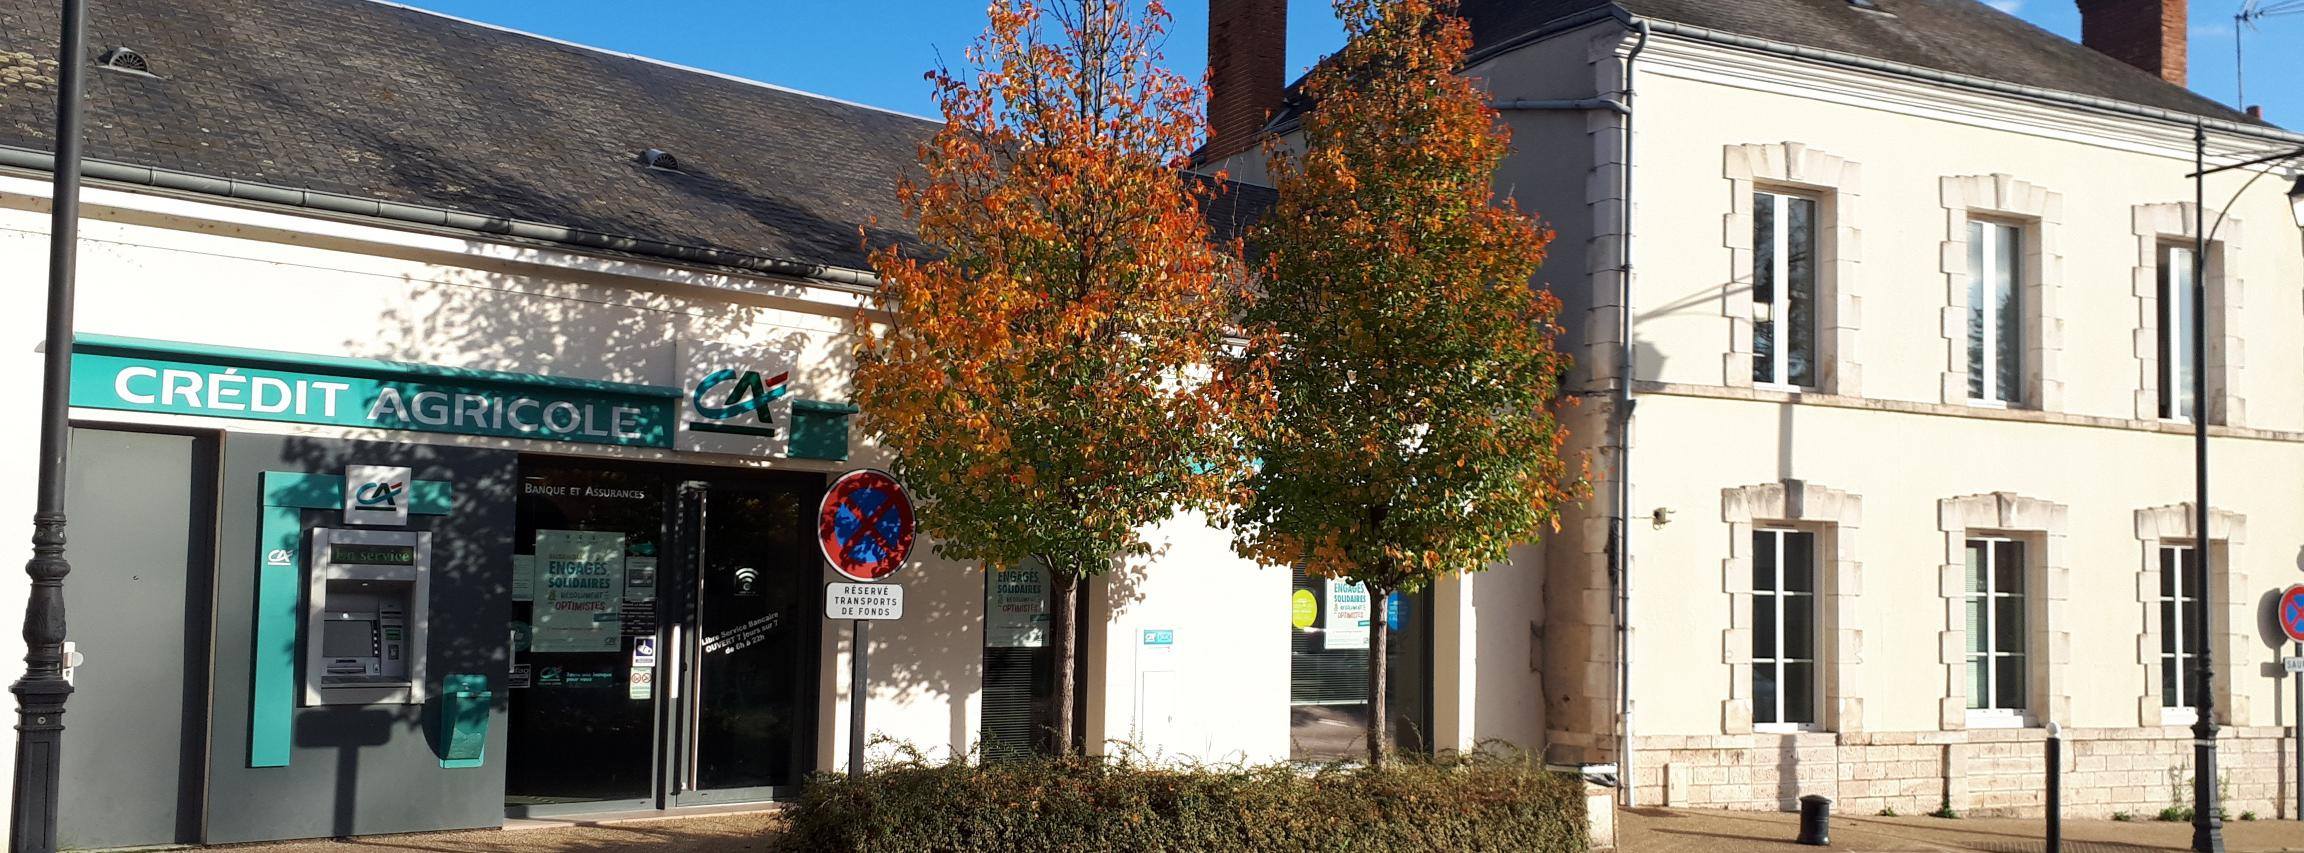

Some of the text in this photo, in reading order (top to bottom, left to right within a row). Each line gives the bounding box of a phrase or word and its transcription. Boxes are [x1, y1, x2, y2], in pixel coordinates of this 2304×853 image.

[114, 366, 642, 439] CRÉDIT AGRICOLE
[548, 577, 610, 589] SOLIDAIRES
[844, 585, 889, 595] RÉSERVÉ
[997, 584, 1042, 594] SOLIDAIRES
[835, 596, 897, 606] TRANSPORTS
[1334, 594, 1367, 603] SOLIDAIRES
[555, 600, 607, 611] OPTIMISTES
[841, 607, 890, 616] DE FONDS
[701, 612, 779, 646] Libre Service Bancaire
[705, 636, 735, 653] OUVERT
[742, 627, 760, 640] jours
[761, 622, 773, 631] sur
[725, 646, 735, 654] de
[2286, 660, 2304, 669] SAU
